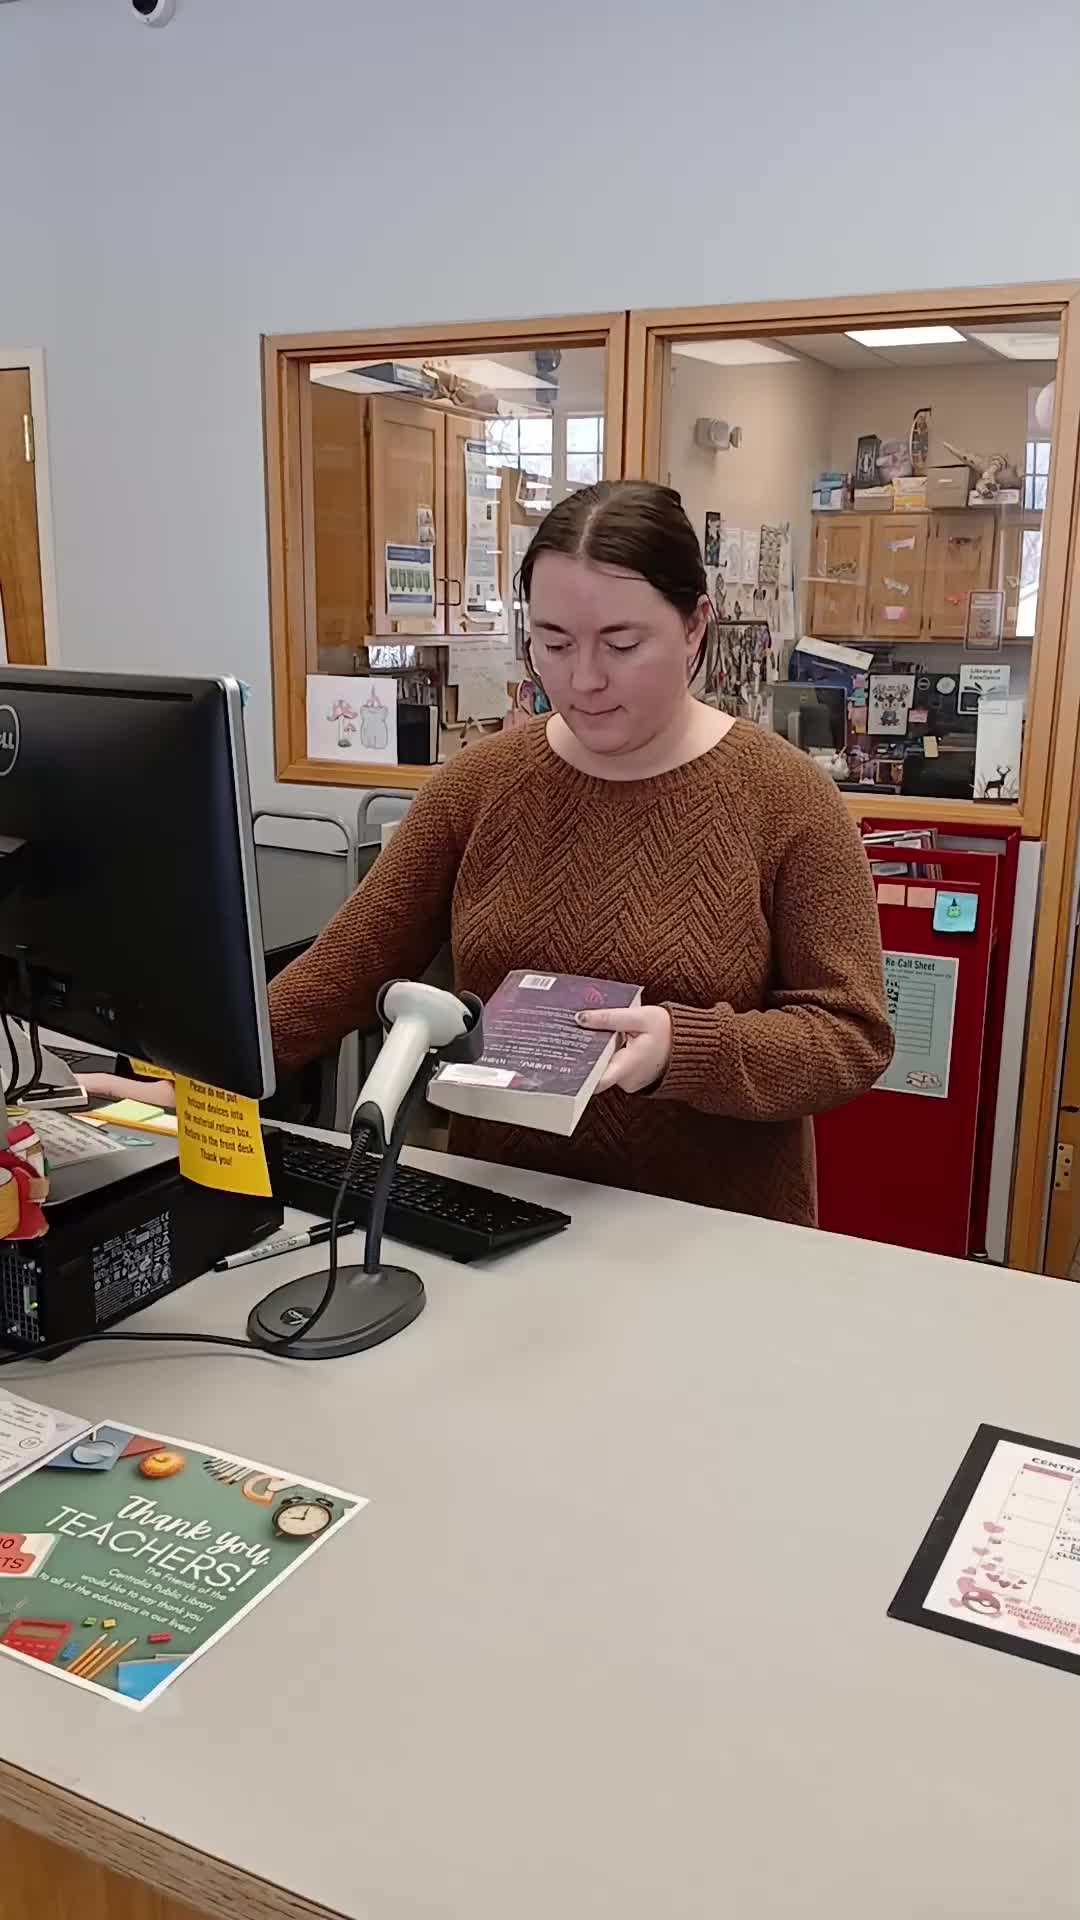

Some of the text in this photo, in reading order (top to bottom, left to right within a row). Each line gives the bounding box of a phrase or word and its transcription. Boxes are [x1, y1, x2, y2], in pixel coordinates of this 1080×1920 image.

[0, 731, 15, 749] LL
[898, 958, 912, 969] Call
[914, 960, 936, 971] Sheet
[189, 1079, 238, 1104] Please do not put
[207, 1102, 229, 1118] devices
[230, 1108, 243, 1121] into
[184, 1125, 201, 1141] Return
[208, 1136, 218, 1148] the
[219, 1138, 236, 1152] front
[192, 1115, 215, 1129] material
[215, 1122, 236, 1136] return
[200, 1147, 232, 1167] Thank you!
[117, 1495, 212, 1541] Thank
[45, 1505, 257, 1593] TEACHERS!
[0, 1557, 25, 1569] TS
[108, 1568, 217, 1613] Centralia Public Library
[145, 1567, 162, 1578] The
[161, 1573, 197, 1591] Friends
[210, 1590, 228, 1601] the
[49, 1576, 66, 1586] all
[62, 1580, 77, 1591] of
[75, 1584, 93, 1597] the
[91, 1592, 141, 1615] educators
[139, 1607, 150, 1617] in
[150, 1613, 169, 1624] our
[167, 1617, 198, 1635] lives!
[80, 1574, 205, 1624] would like to say thank you
